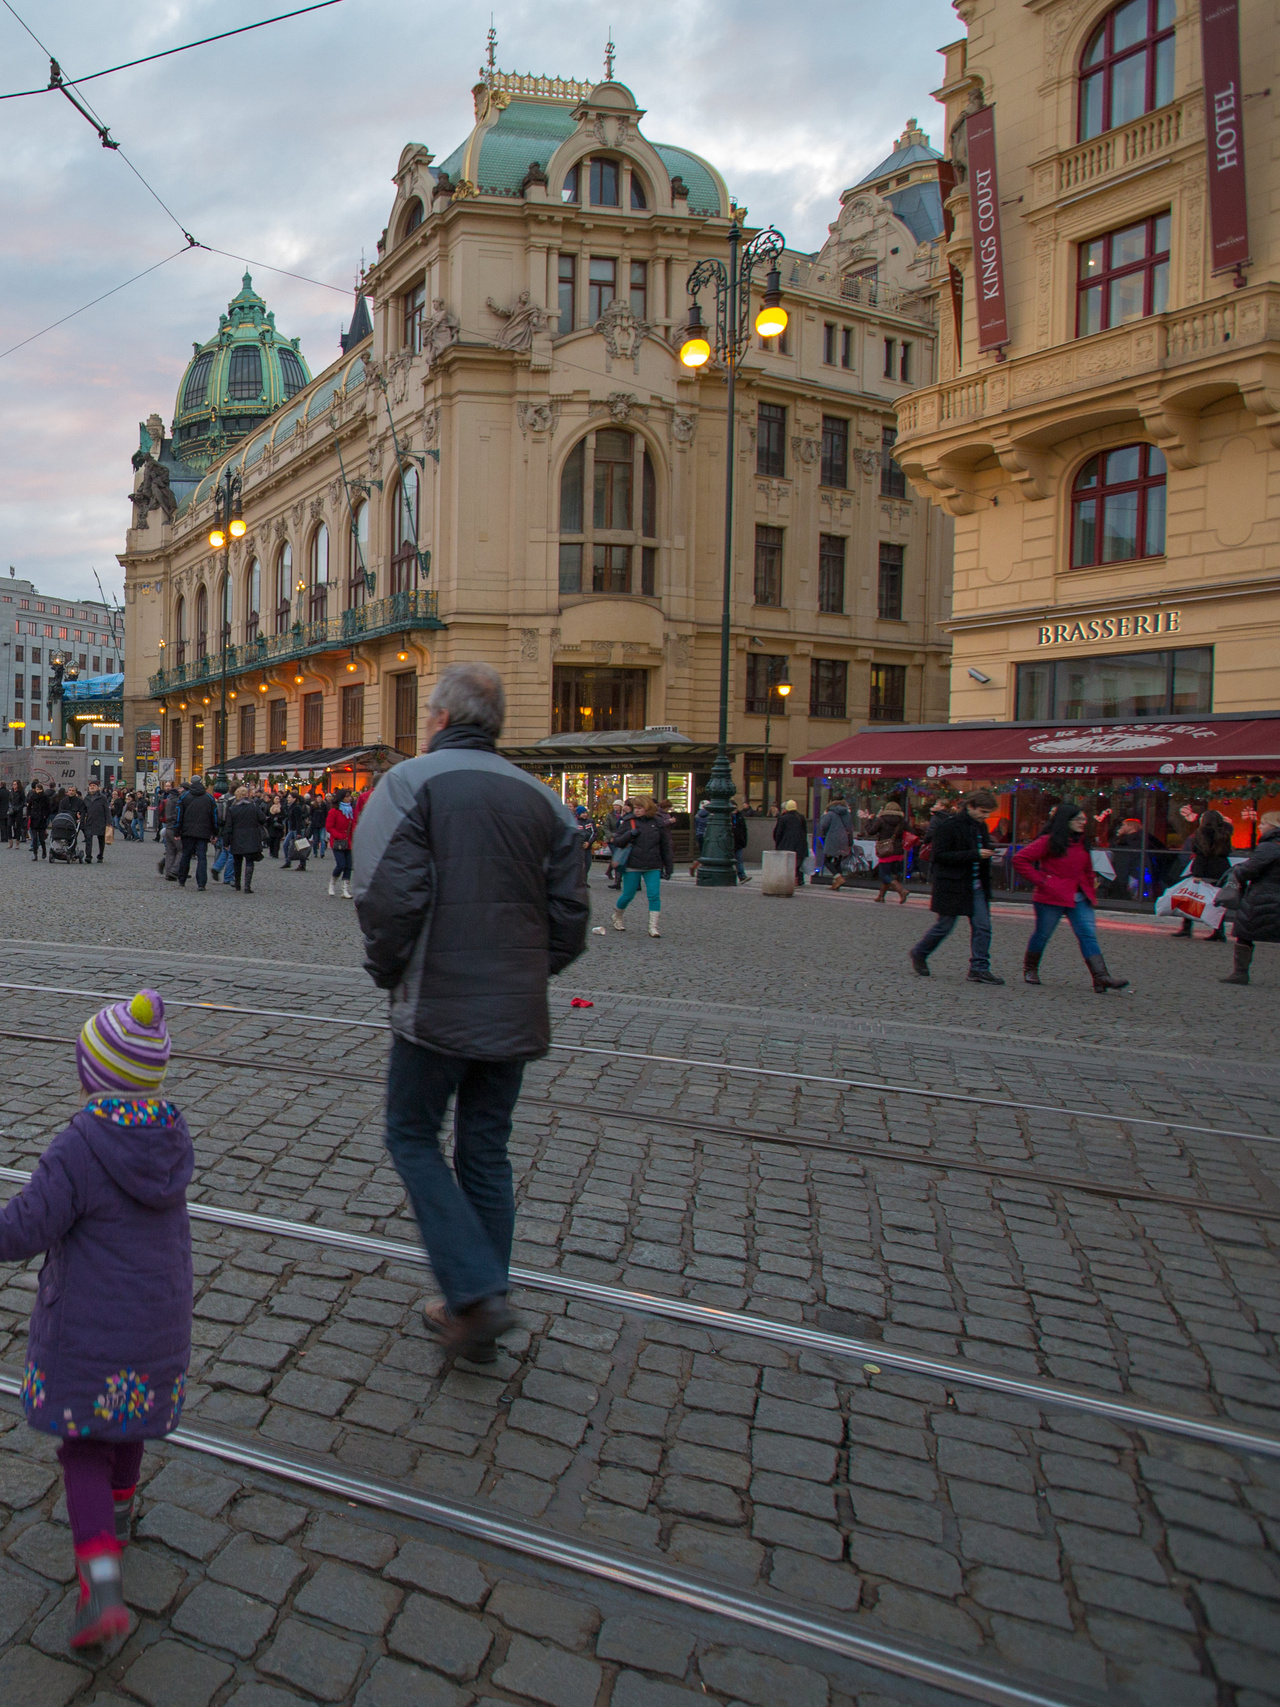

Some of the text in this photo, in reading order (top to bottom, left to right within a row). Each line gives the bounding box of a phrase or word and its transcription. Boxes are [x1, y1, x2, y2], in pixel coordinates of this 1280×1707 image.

[1214, 81, 1238, 173] HOTEL
[976, 168, 995, 232] COURT
[980, 235, 1000, 301] KINGS
[1037, 611, 1181, 646] BRASSERIE
[61, 769, 76, 778] HD
[823, 767, 882, 775] BRASSERIE
[1020, 766, 1099, 774] BRASSERIE
